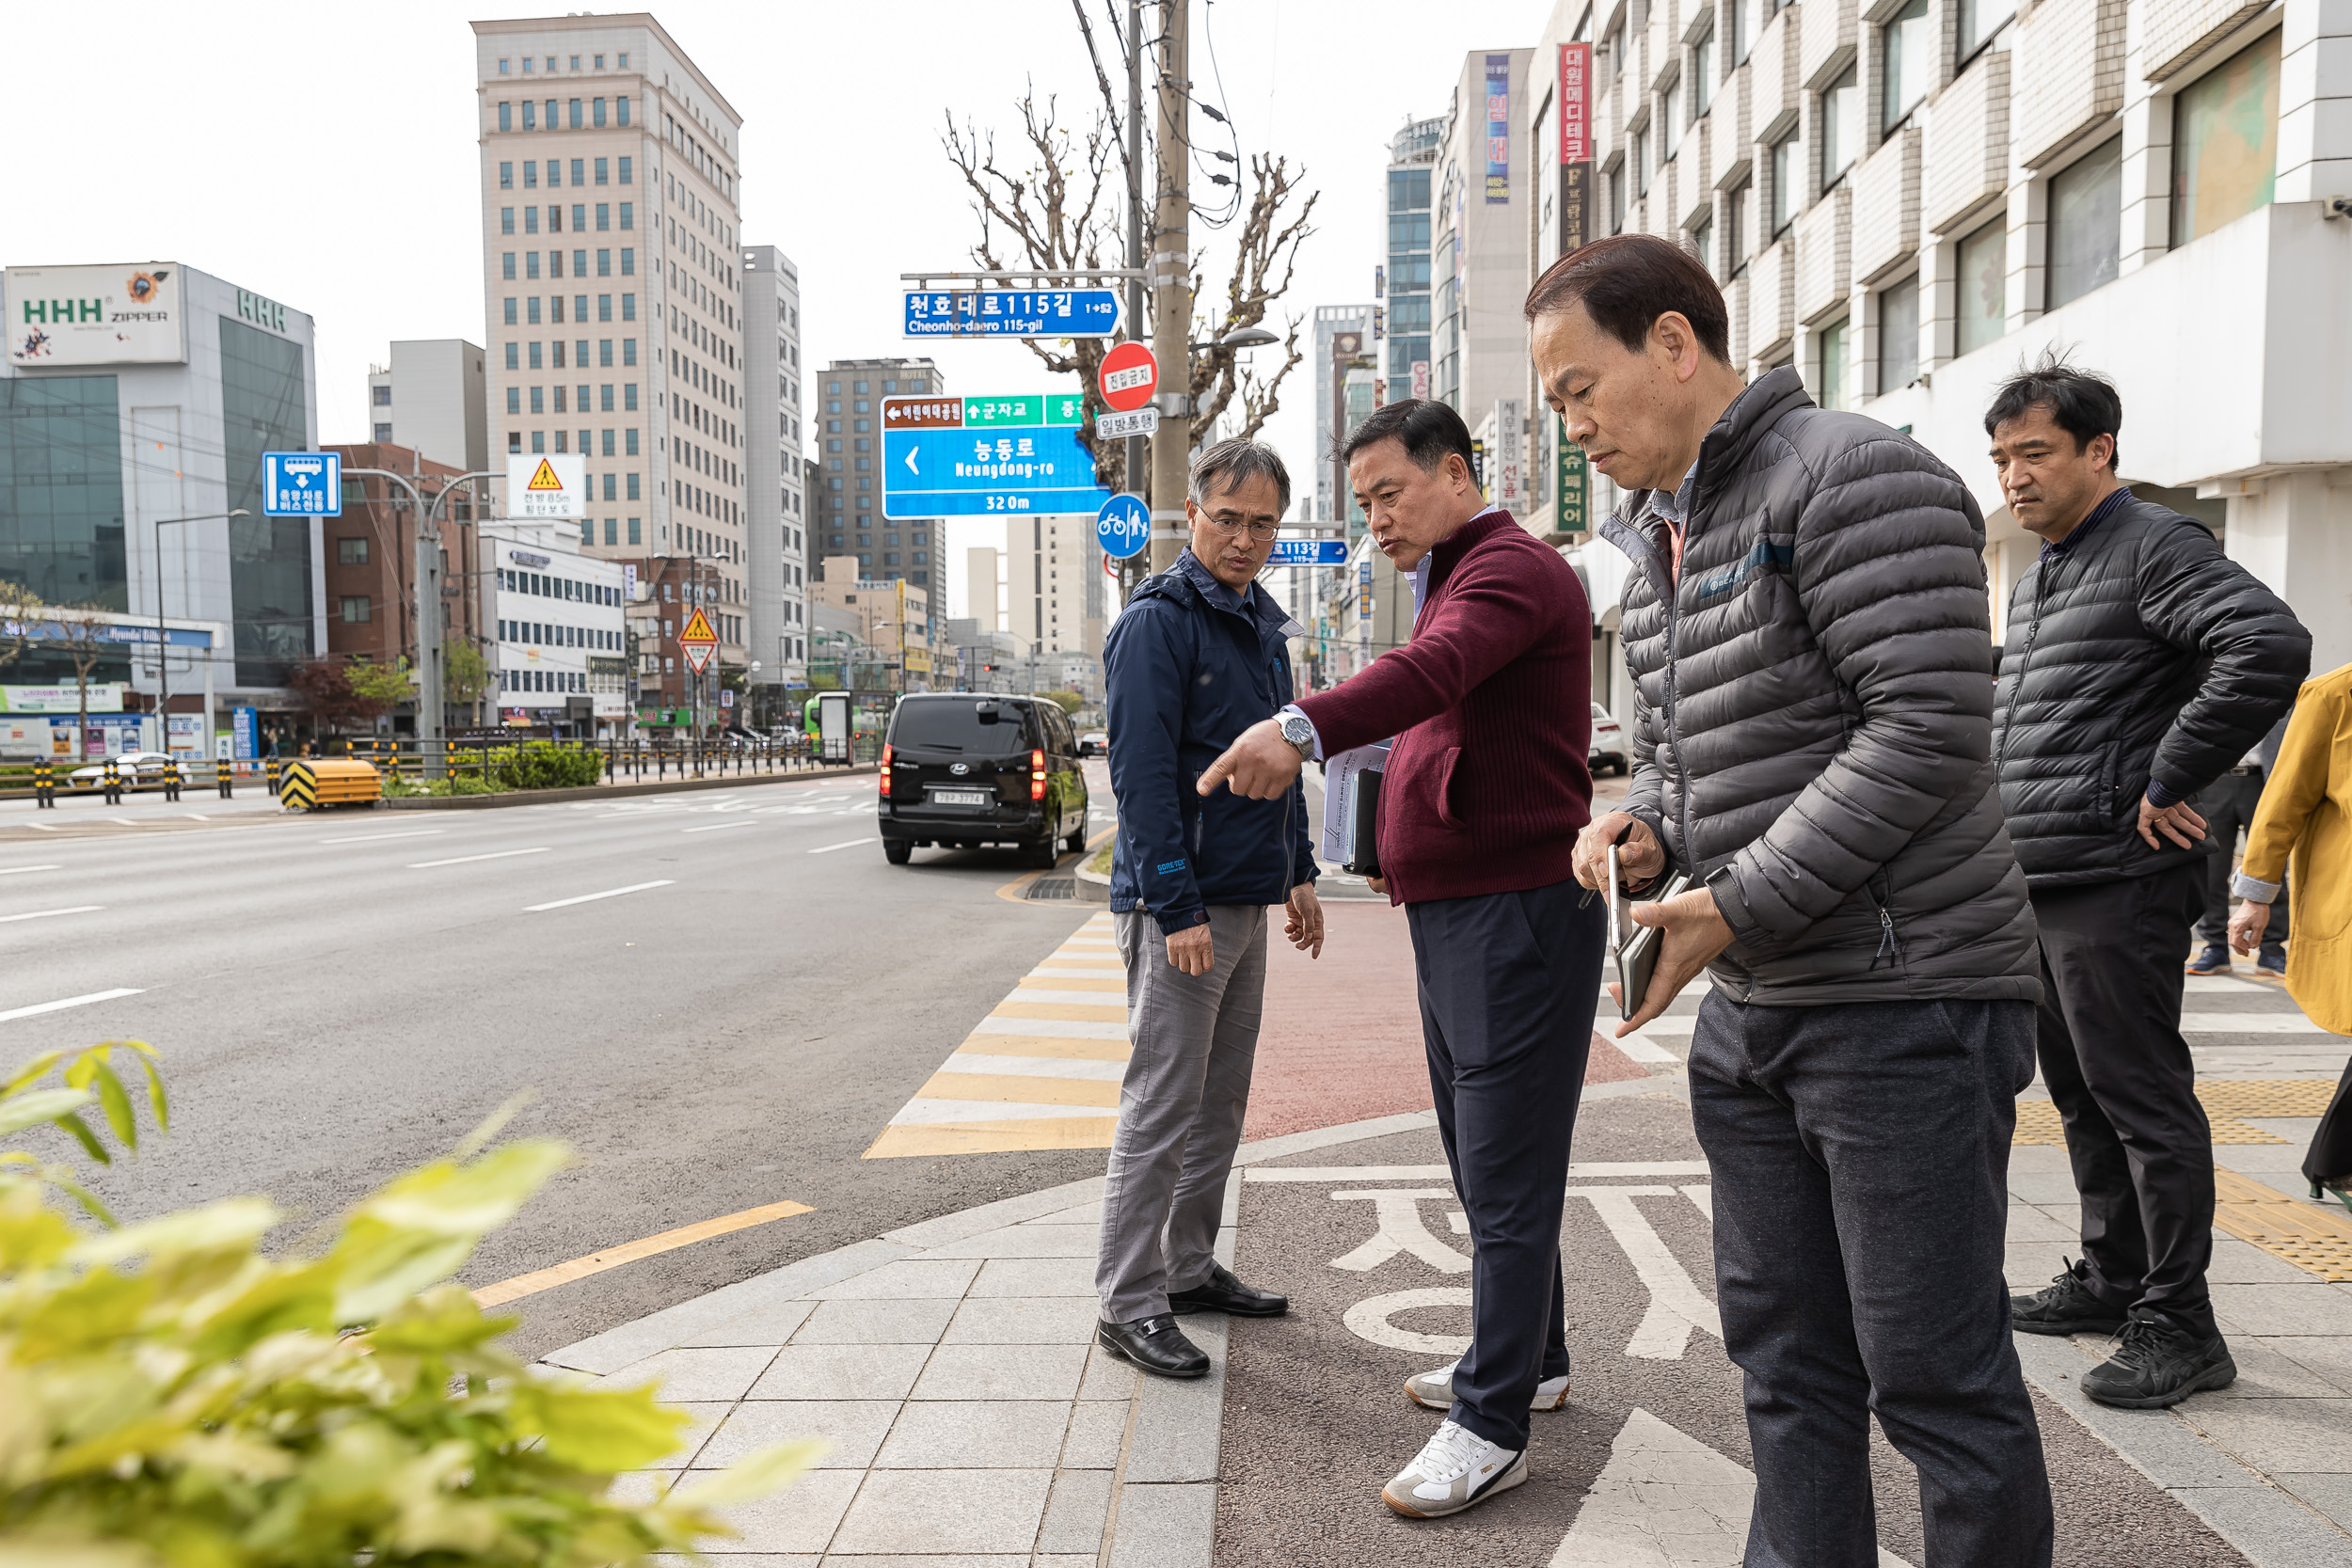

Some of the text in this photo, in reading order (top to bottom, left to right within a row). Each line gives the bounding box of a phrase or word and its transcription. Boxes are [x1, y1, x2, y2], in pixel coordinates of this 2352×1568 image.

[1488, 96, 1507, 164] 임대
[24, 298, 168, 324] HHH ZIPPER
[237, 289, 287, 333] HHH
[909, 293, 1073, 318] 천호대로115길
[908, 319, 1043, 333] Cheonho-daero 115-gil
[1110, 368, 1148, 389] 진입금지
[902, 403, 961, 421] 어린이대공원
[982, 403, 1027, 420] 군자교
[1102, 414, 1152, 434] 일방통행
[974, 438, 1036, 462] 능동로
[955, 461, 1055, 480] Neungdong-ro
[279, 489, 325, 501] 중앙차로
[1562, 455, 1583, 523] 슈페리어
[279, 499, 325, 513] 버스전용
[986, 495, 1030, 510] 320m
[1269, 542, 1320, 557] 로113길
[109, 627, 141, 642] Hyundai
